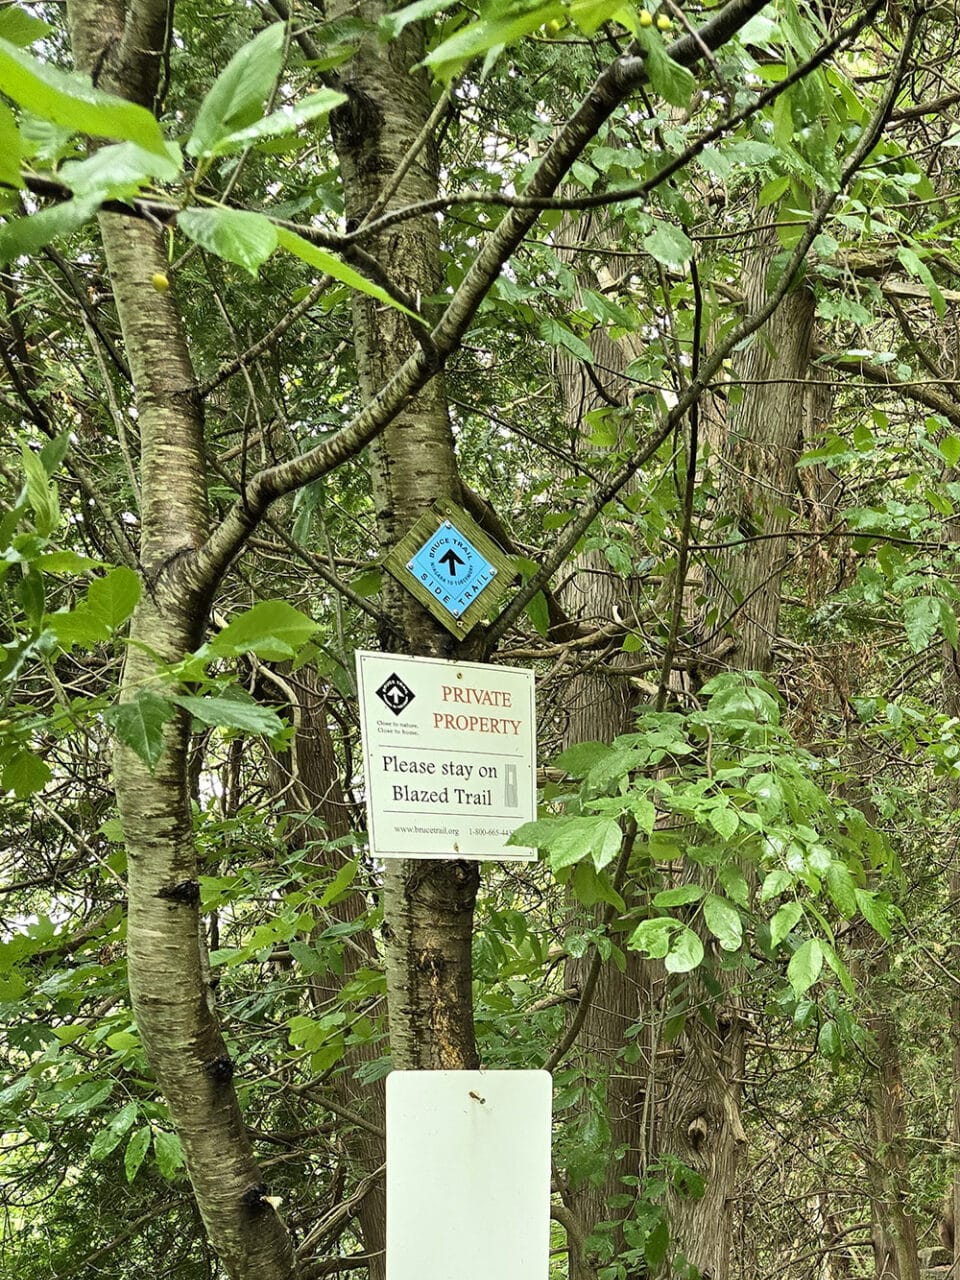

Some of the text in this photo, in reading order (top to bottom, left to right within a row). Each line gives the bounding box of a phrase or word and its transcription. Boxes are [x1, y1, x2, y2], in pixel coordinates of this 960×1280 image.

[429, 538, 472, 560] BRUCE TRAIL
[420, 573, 488, 605] SIDE TRAIL
[442, 685, 512, 708] PRIVATE
[433, 713, 522, 736] PROPERTY
[382, 756, 498, 781] Please stay on
[392, 786, 492, 806] Blazed Trail
[394, 826, 513, 836] www.brucetrail.org 1-800-665-445
